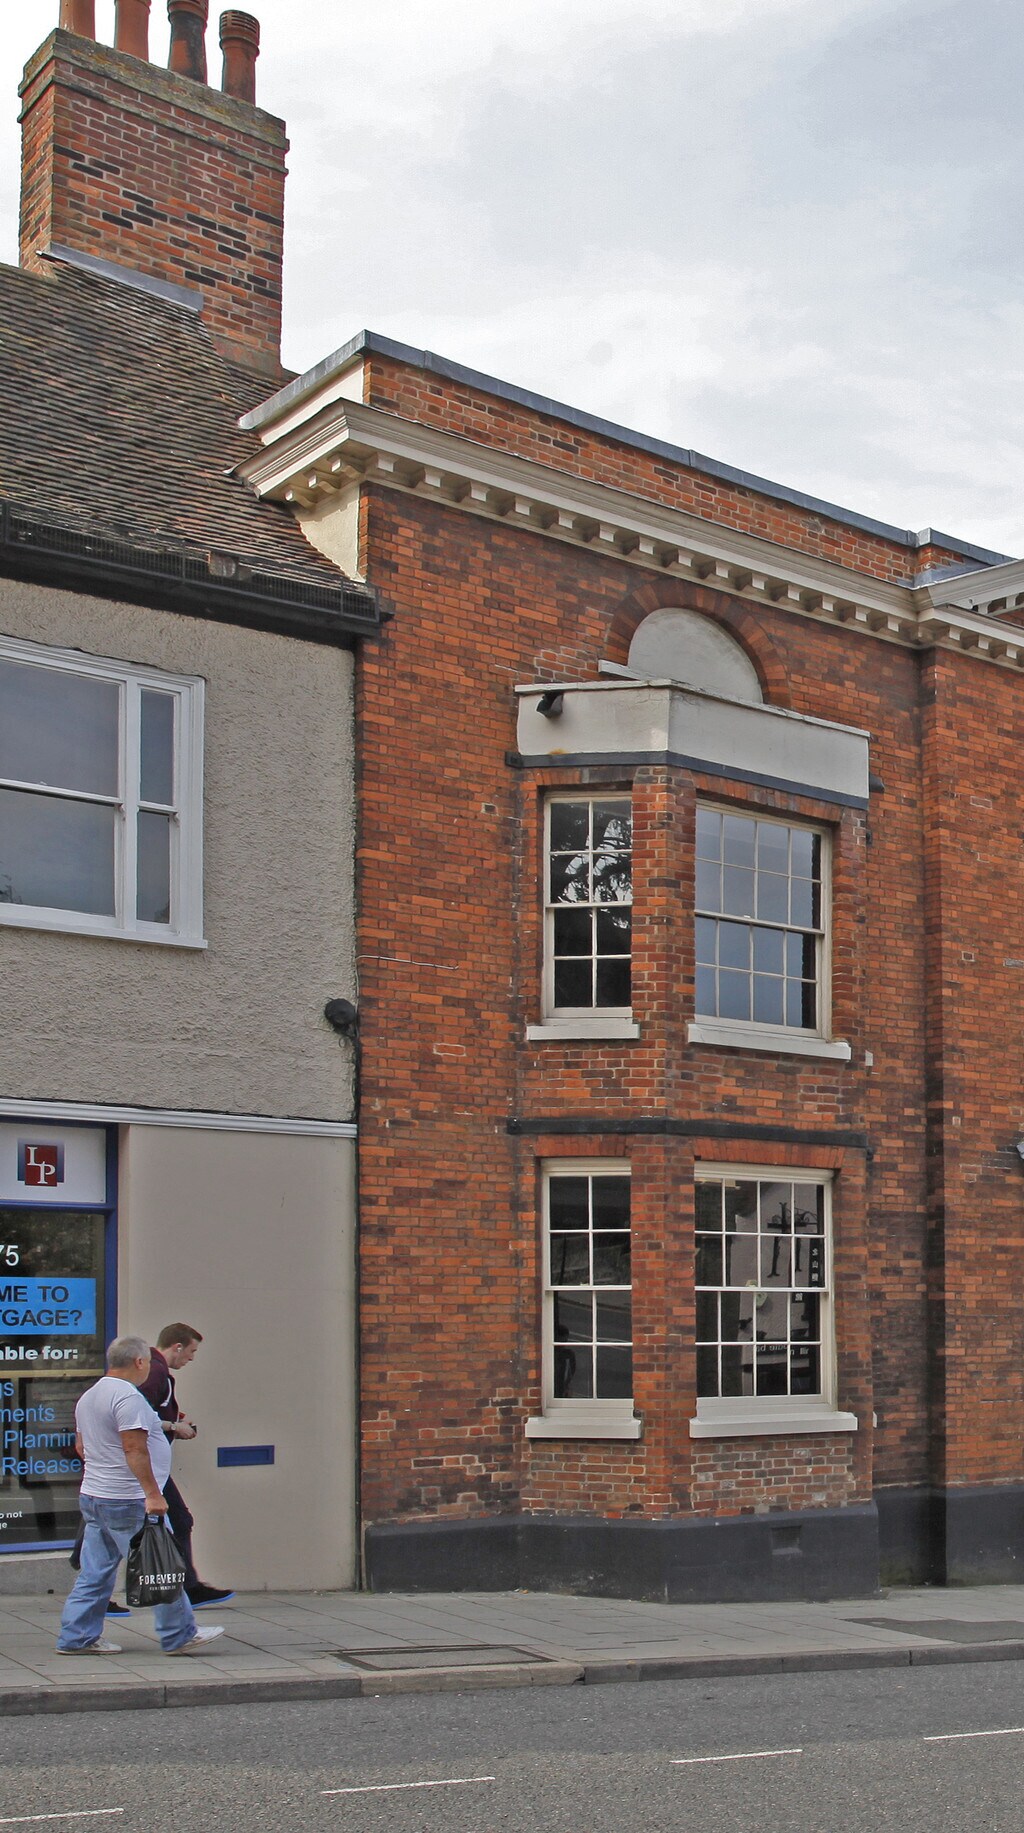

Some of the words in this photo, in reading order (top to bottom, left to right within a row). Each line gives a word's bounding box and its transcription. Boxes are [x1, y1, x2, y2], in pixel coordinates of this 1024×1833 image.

[0, 1245, 19, 1266] 5
[37, 1286, 69, 1302] TO
[0, 1309, 82, 1326] GAGE?
[42, 1345, 78, 1360] for:
[0, 1382, 14, 1399] s
[4, 1429, 76, 1449] Plannin
[2, 1457, 81, 1475] Release
[6, 1510, 23, 1518] not
